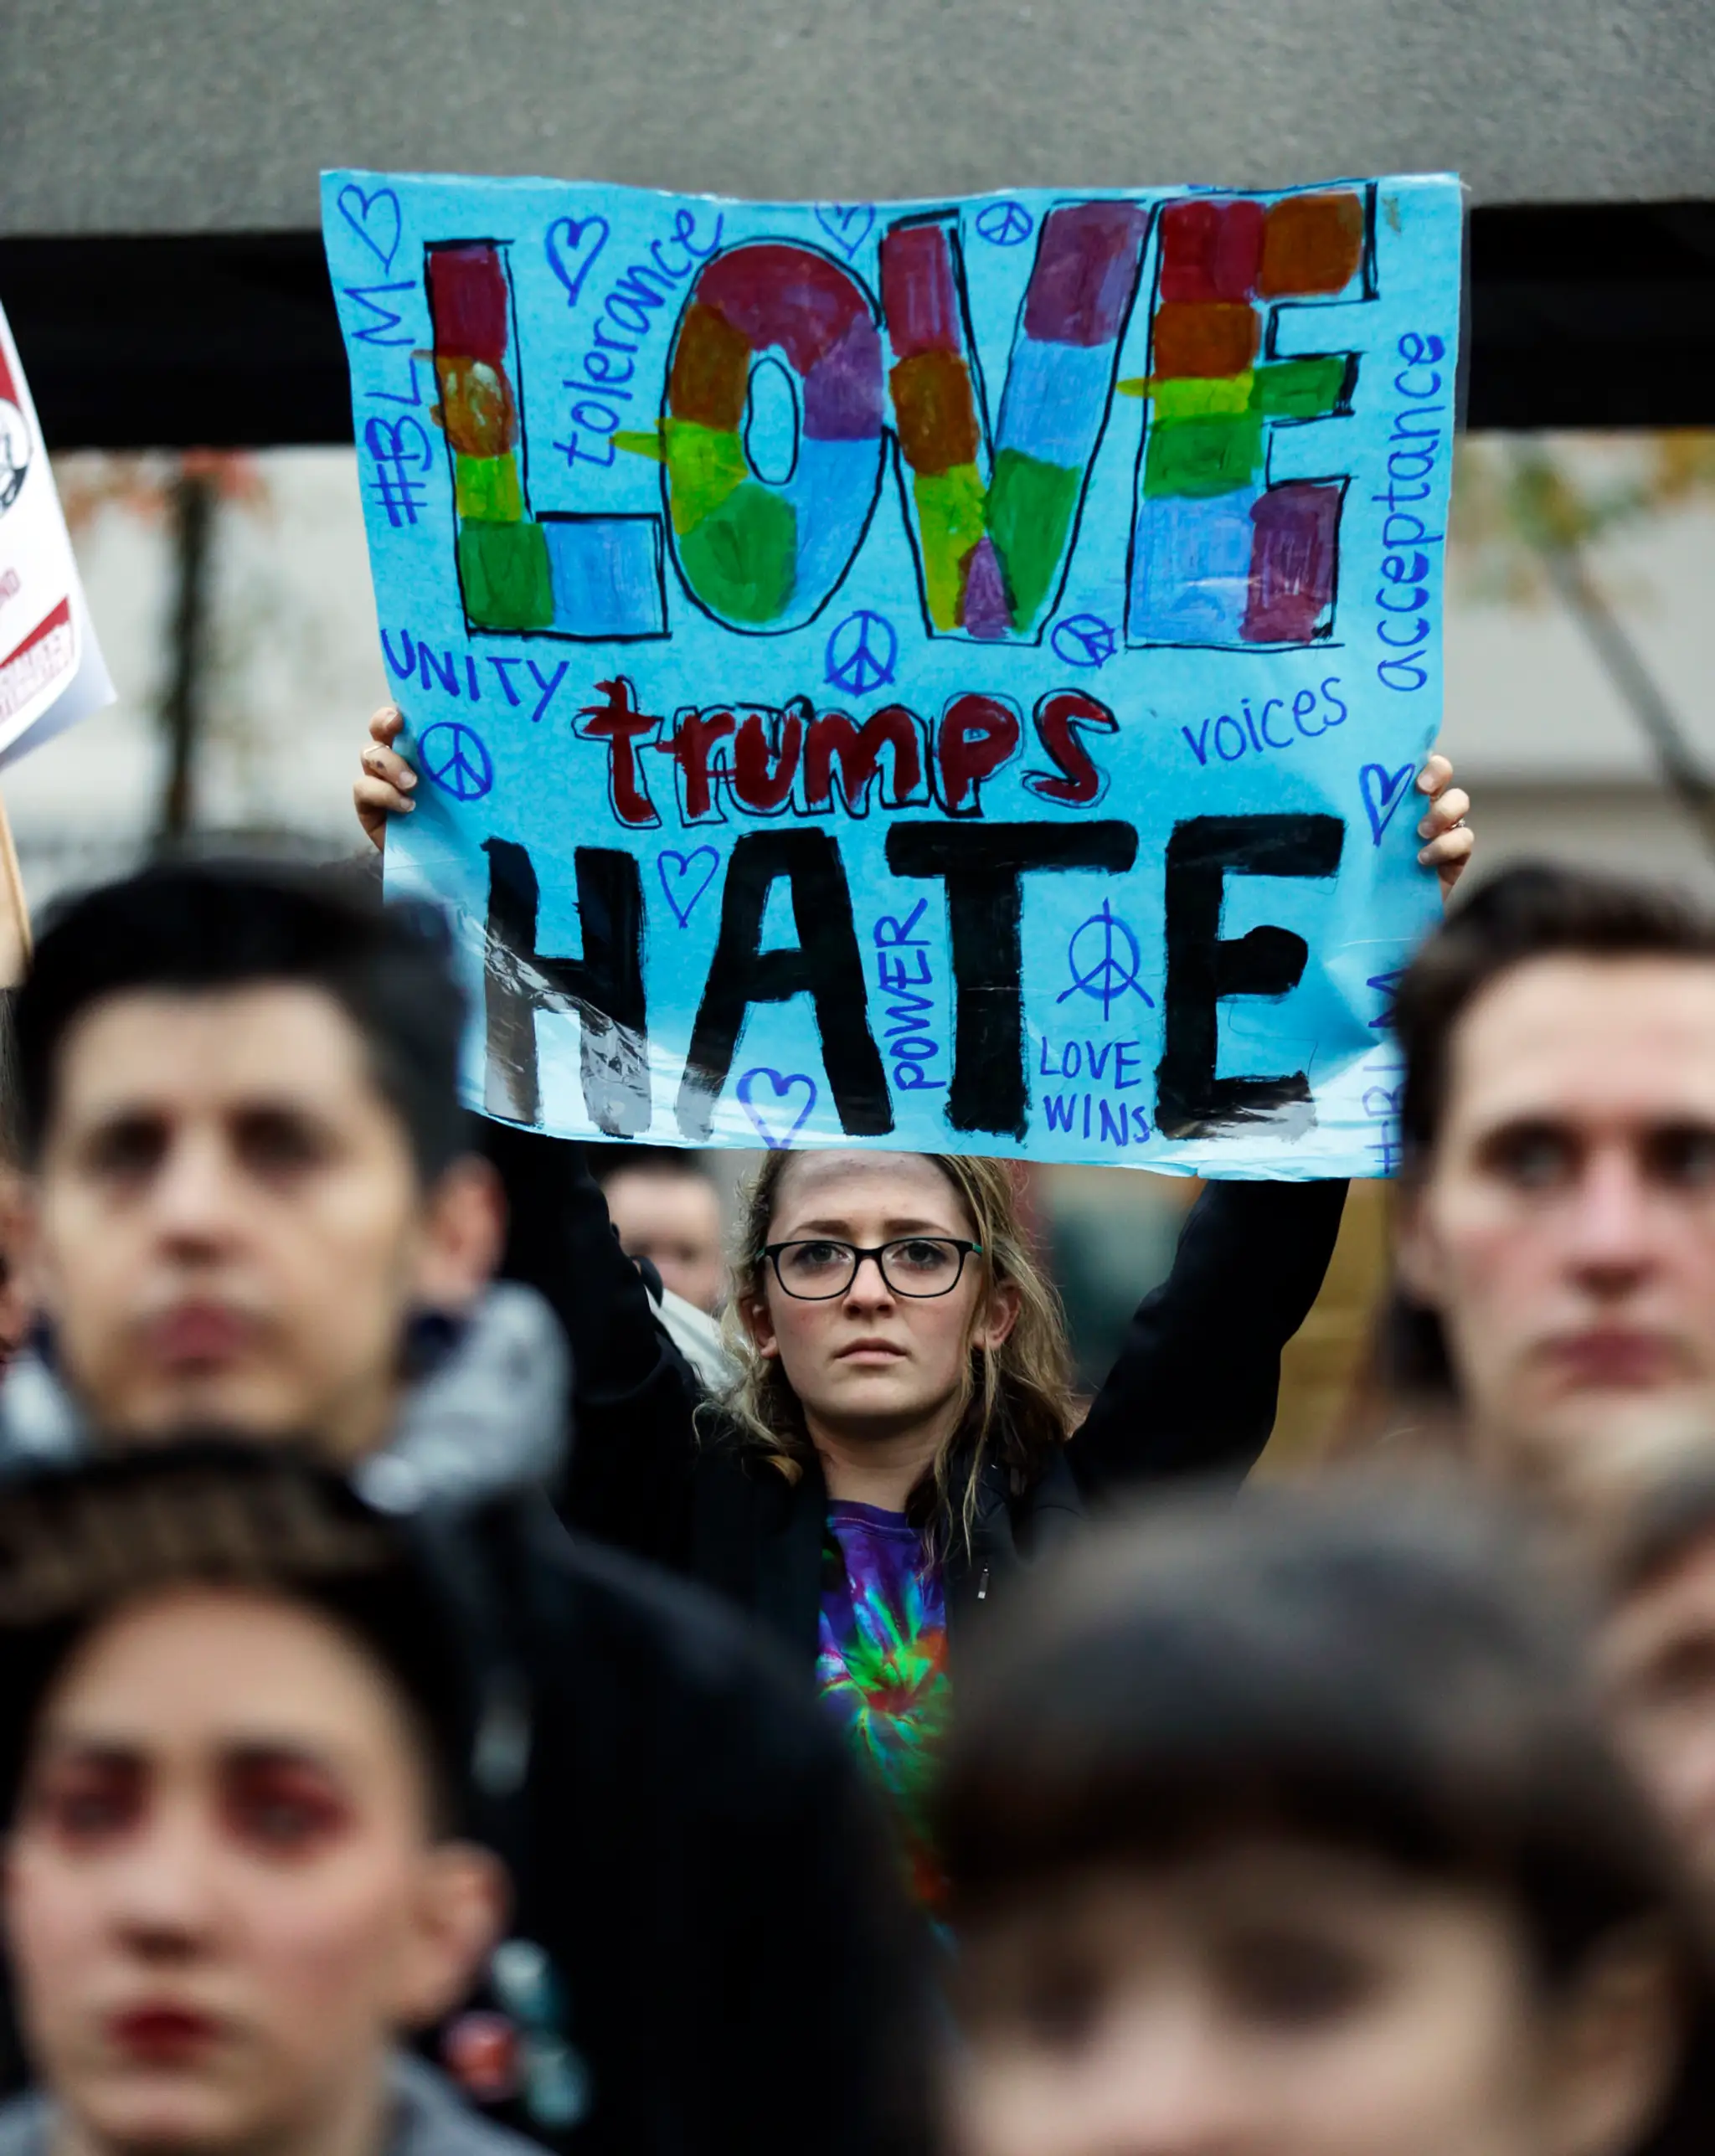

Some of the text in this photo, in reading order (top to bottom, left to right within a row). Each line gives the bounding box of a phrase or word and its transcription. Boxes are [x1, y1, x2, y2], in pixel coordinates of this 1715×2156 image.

[342, 280, 432, 528] #BLM
[423, 178, 1380, 652] LOVE
[554, 208, 724, 468] tolerance
[1373, 332, 1445, 692] acceptance
[380, 628, 569, 723] UNITY
[572, 674, 1120, 829] trumps
[1181, 677, 1348, 766] voices
[480, 811, 1347, 1147] HATE
[873, 898, 947, 1092] POWER
[1038, 1035, 1142, 1089] LOVE
[1043, 1093, 1154, 1146] WINS
